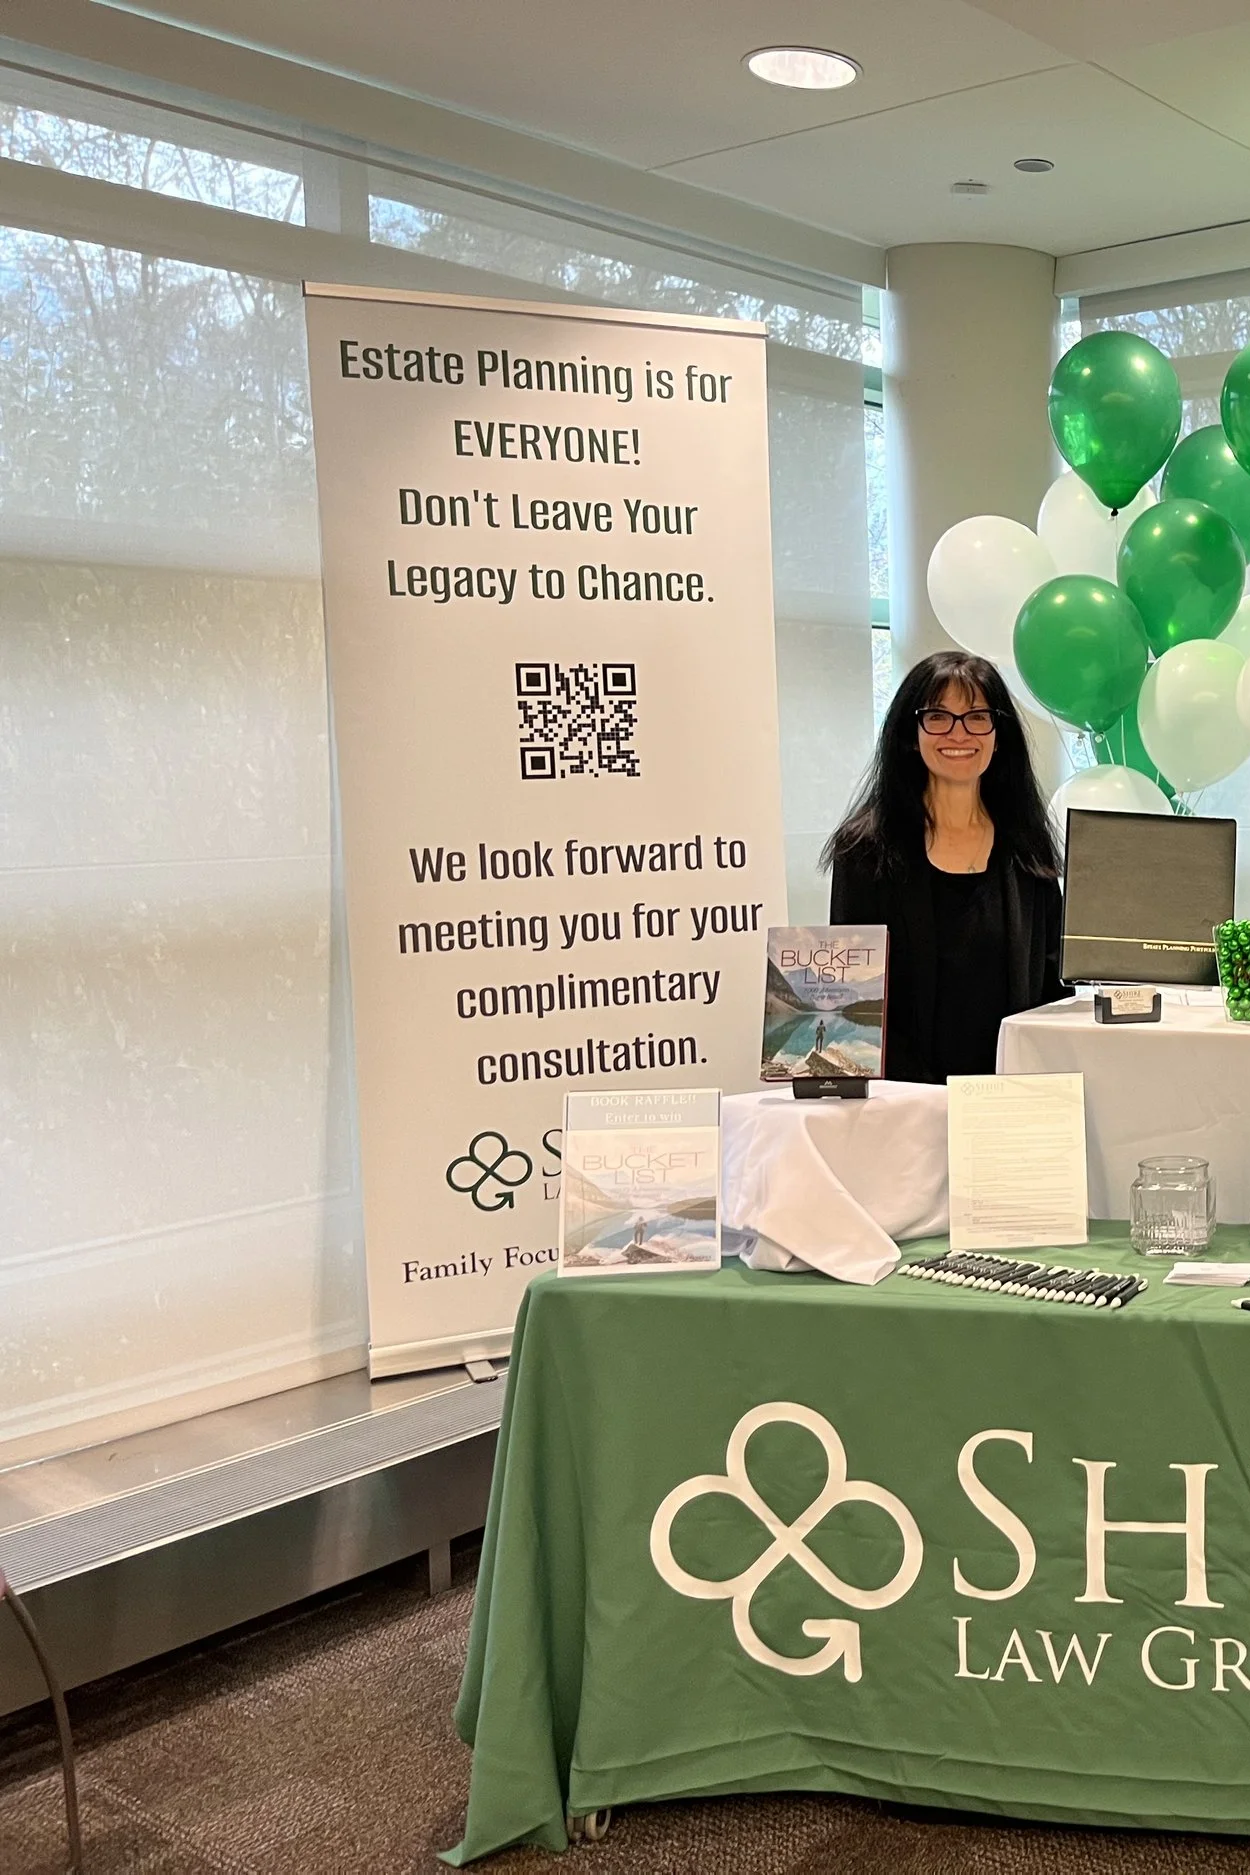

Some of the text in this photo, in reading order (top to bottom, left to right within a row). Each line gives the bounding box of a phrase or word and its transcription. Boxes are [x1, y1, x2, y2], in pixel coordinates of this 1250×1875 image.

[339, 339, 733, 404] Estate Planning is for
[453, 419, 641, 466] EVERYONE!
[398, 488, 698, 535] Don't Leave Your
[387, 559, 714, 605] Legacy to Chance.
[408, 834, 746, 884] We look forward to
[398, 902, 763, 954] meeting you for your
[781, 949, 876, 967] BUCKET
[804, 967, 850, 984] LIST
[456, 969, 721, 1019] complimentary
[477, 1032, 708, 1085] consultation.
[590, 1096, 628, 1106] BOOK
[605, 1112, 682, 1122] Enter to win
[583, 1152, 705, 1170] BUCKET
[615, 1168, 673, 1184] LIST
[402, 1246, 559, 1284] Family Focu
[952, 1616, 1113, 1686] LAW
